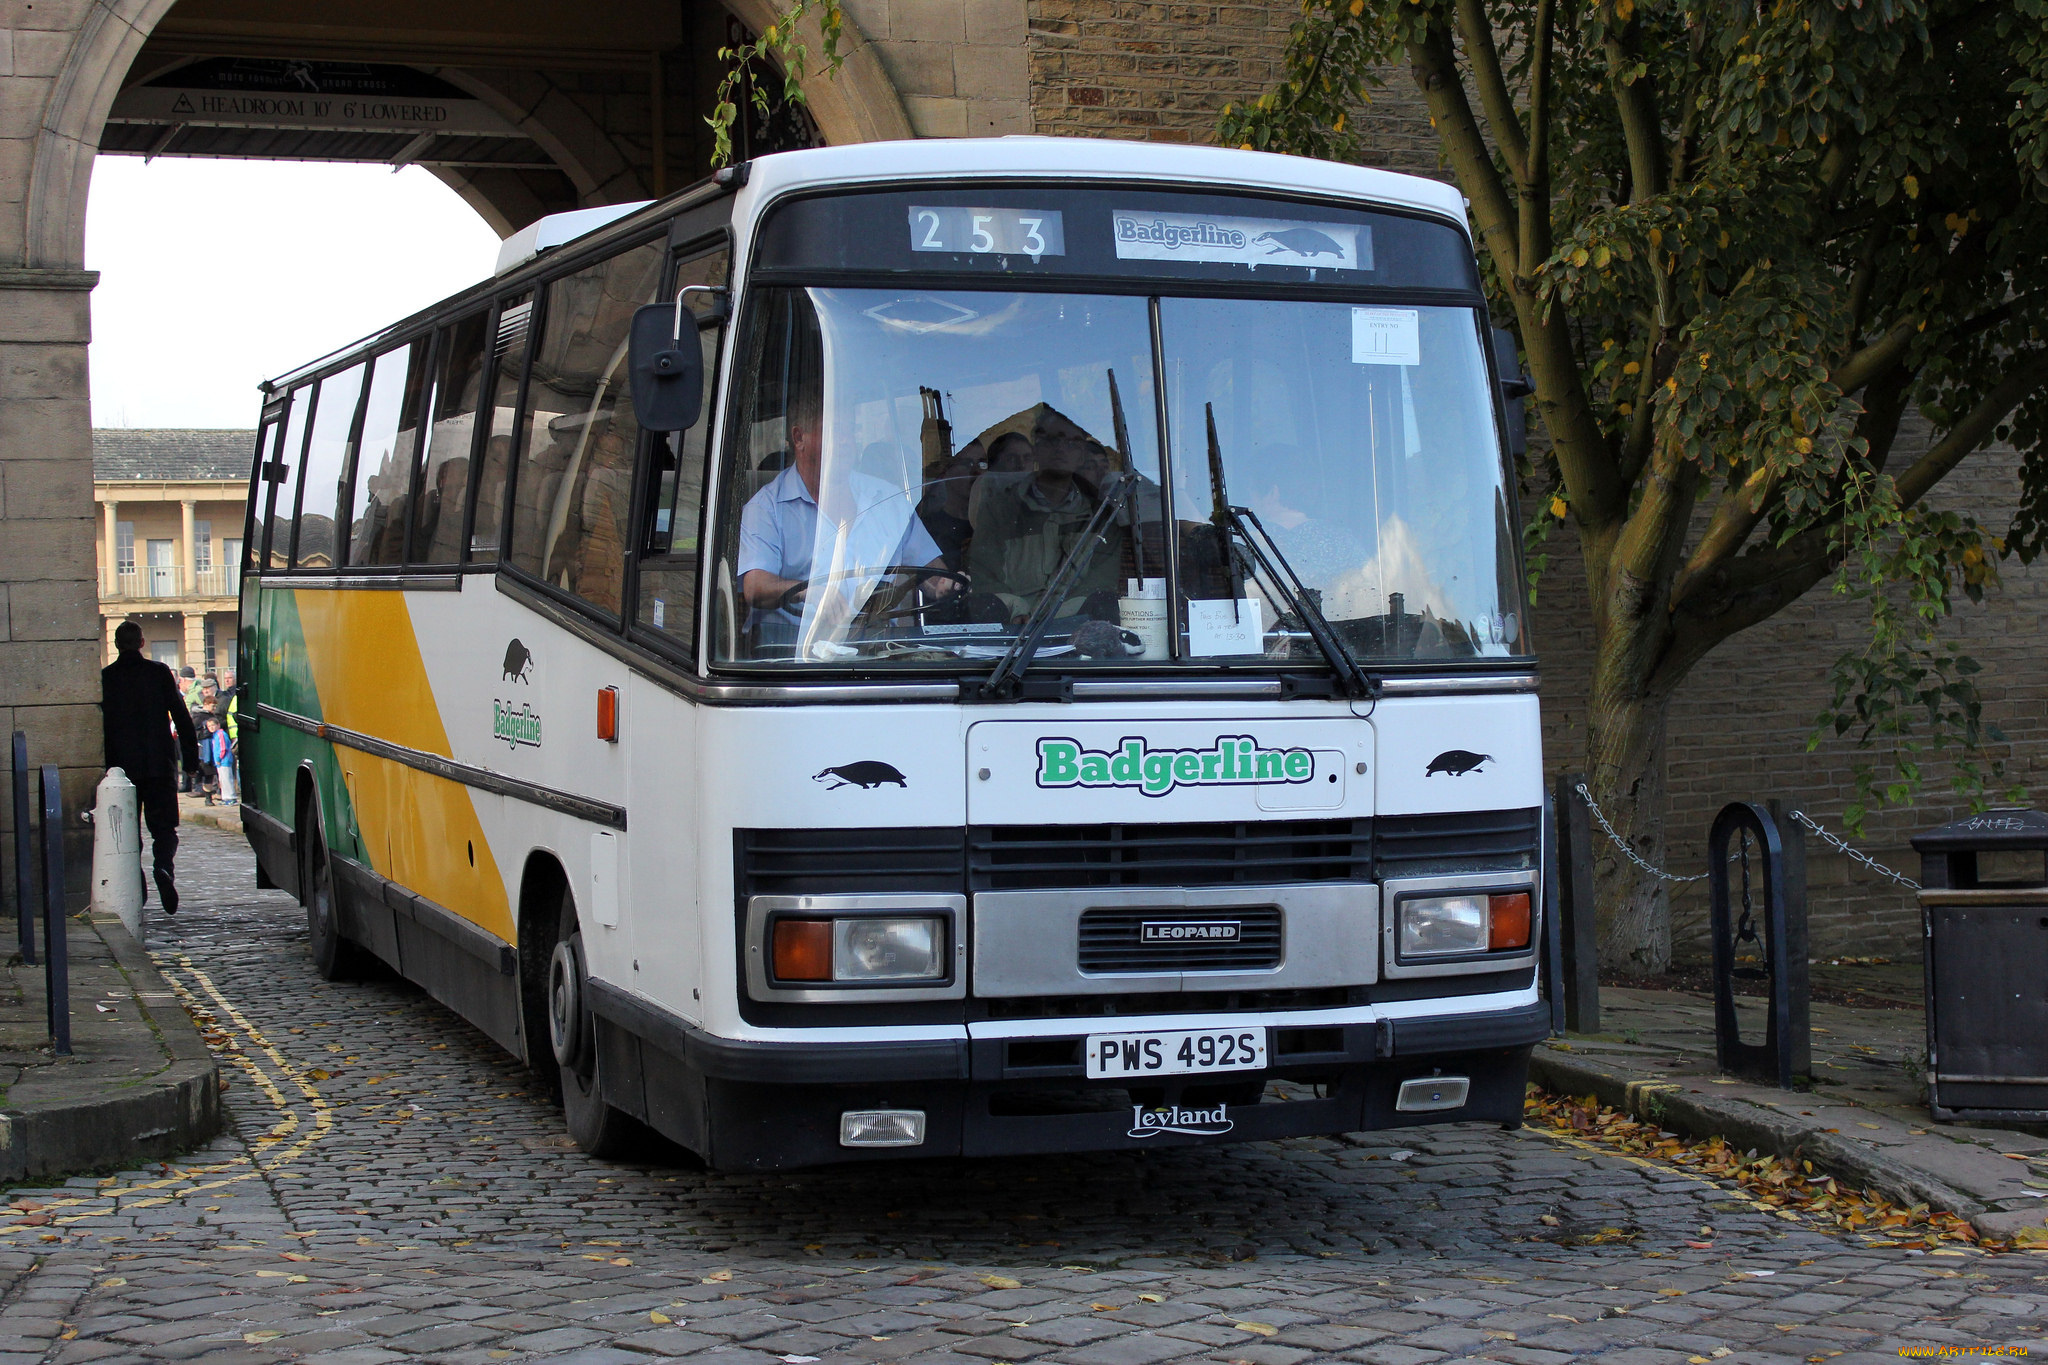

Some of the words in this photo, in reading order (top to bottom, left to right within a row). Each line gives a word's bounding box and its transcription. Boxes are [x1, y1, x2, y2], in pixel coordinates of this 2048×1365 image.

[201, 95, 305, 117] HEADROOM
[361, 103, 447, 122] LOWERED
[1118, 218, 1244, 248] Badgerline
[494, 701, 541, 748] Badgerline
[1040, 738, 1311, 793] Badgerline
[1145, 925, 1237, 940] LEOPARD
[1099, 1038, 1163, 1073] PWS
[1176, 1033, 1257, 1068] 492S
[1131, 1103, 1230, 1134] Leyland
